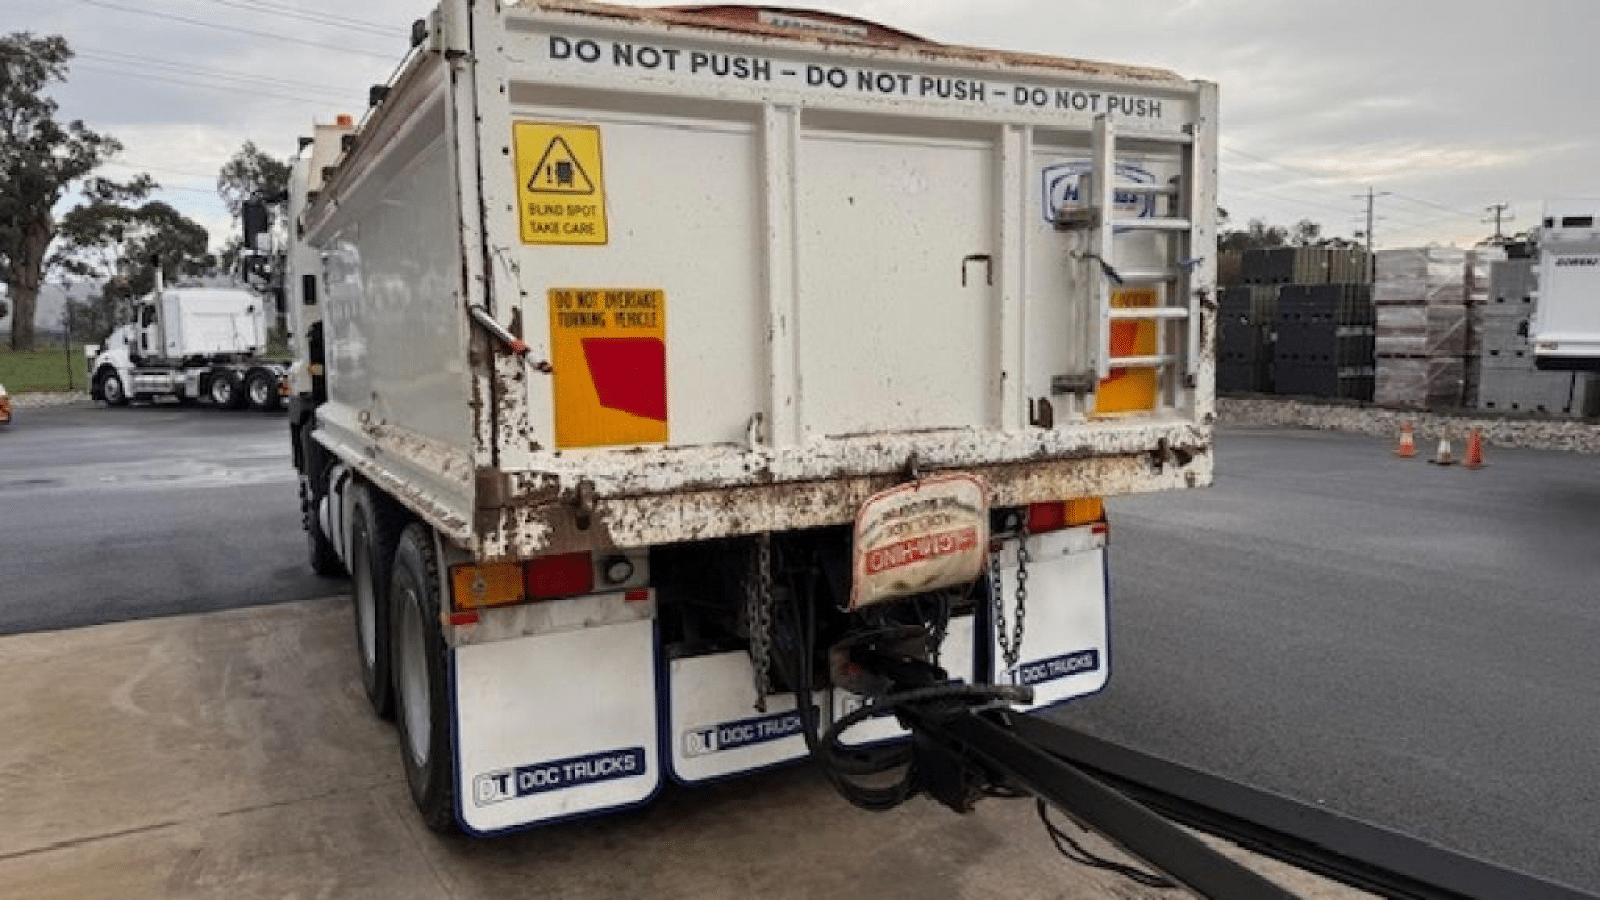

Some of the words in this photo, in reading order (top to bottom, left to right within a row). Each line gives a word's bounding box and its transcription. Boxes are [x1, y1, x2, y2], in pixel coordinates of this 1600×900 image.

[549, 36, 601, 63] DO
[612, 42, 680, 70] NOT
[690, 52, 771, 81] PUSH
[806, 65, 848, 88] DO
[857, 70, 914, 93] NOT
[920, 77, 984, 101] PUSH
[1014, 86, 1048, 106] DO
[1055, 89, 1101, 112] NOT
[1107, 96, 1162, 118] PUSH
[528, 202, 563, 217] BLIND
[566, 204, 597, 217] SPOT
[529, 220, 560, 235] TAKE
[562, 221, 596, 237] CARE
[554, 291, 573, 309] DO
[576, 291, 599, 309] NOT
[604, 290, 656, 309] OVERTAKE
[558, 311, 606, 328] TURNING
[614, 311, 656, 328] VEHICLE
[1021, 664, 1048, 682] DOC
[1048, 653, 1093, 676] TRUCKS
[721, 726, 754, 744] DOC
[519, 766, 560, 791] DOC
[561, 753, 637, 782] TRUCKS
